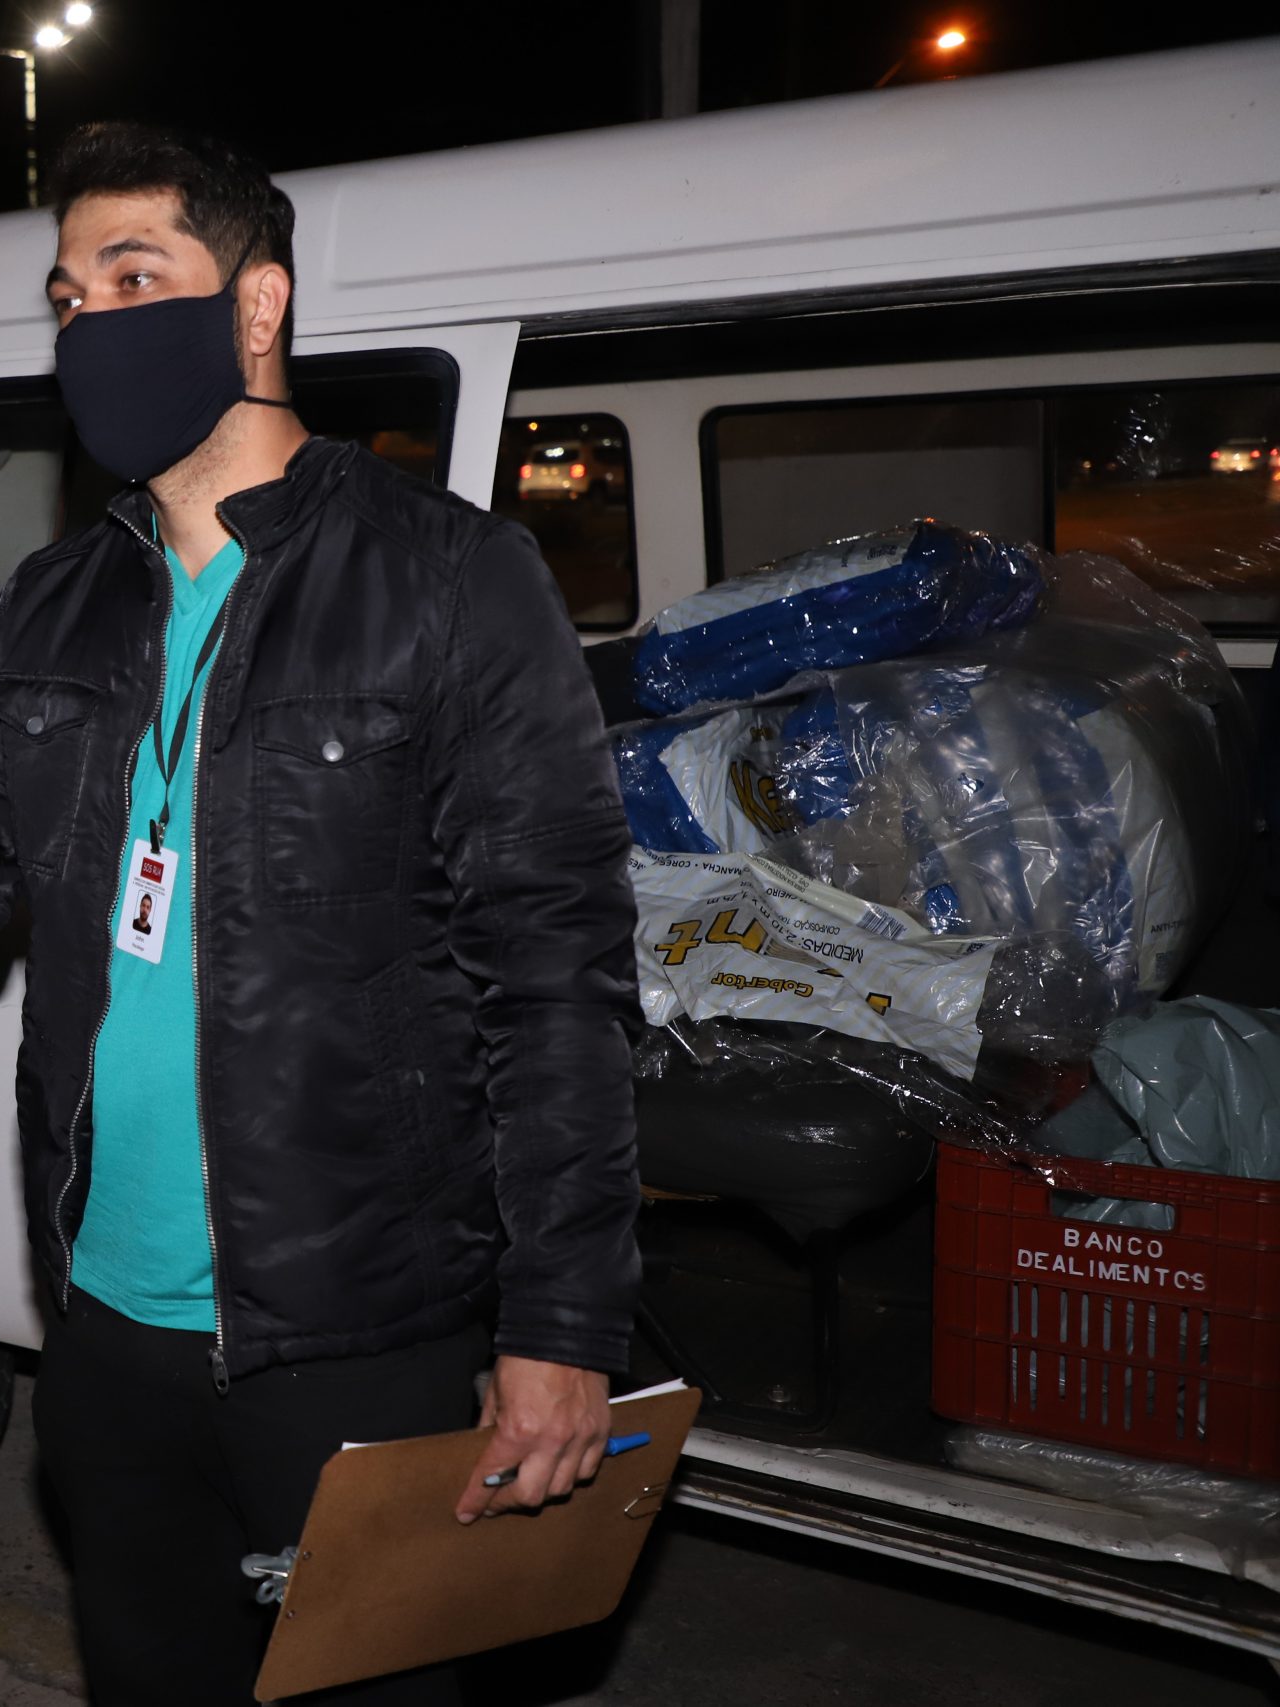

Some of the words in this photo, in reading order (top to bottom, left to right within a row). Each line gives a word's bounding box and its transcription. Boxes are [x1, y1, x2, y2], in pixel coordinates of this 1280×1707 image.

[702, 862, 742, 876] MANCHA
[654, 908, 770, 966] nt
[800, 938, 864, 965] MEDIDAS:
[710, 972, 814, 999] Cobertor
[1063, 1228, 1163, 1258] BANCO
